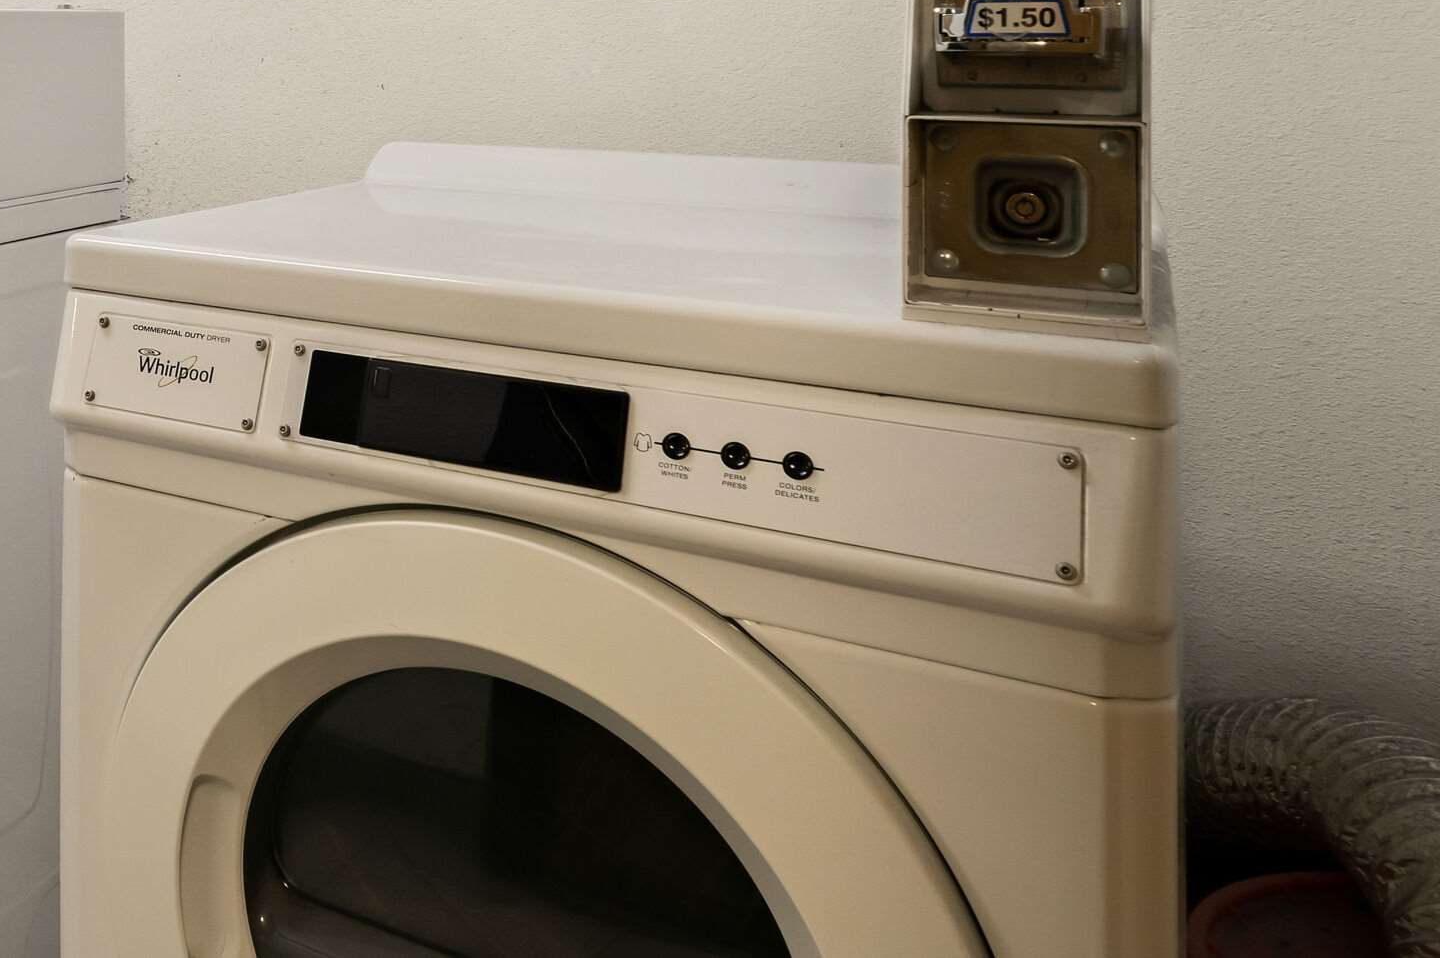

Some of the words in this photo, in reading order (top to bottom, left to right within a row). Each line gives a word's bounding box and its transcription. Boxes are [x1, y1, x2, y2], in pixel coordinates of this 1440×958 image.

[977, 6, 1057, 30] $1.50
[132, 324, 183, 337] COMMERCIAL
[184, 331, 205, 340] DUTY
[206, 334, 231, 344] DRYER
[139, 355, 215, 384] Whirlpool
[661, 471, 689, 480] WHITES
[723, 472, 747, 482] PERM
[721, 480, 748, 490] PRESS
[774, 489, 820, 503] DELICATES
